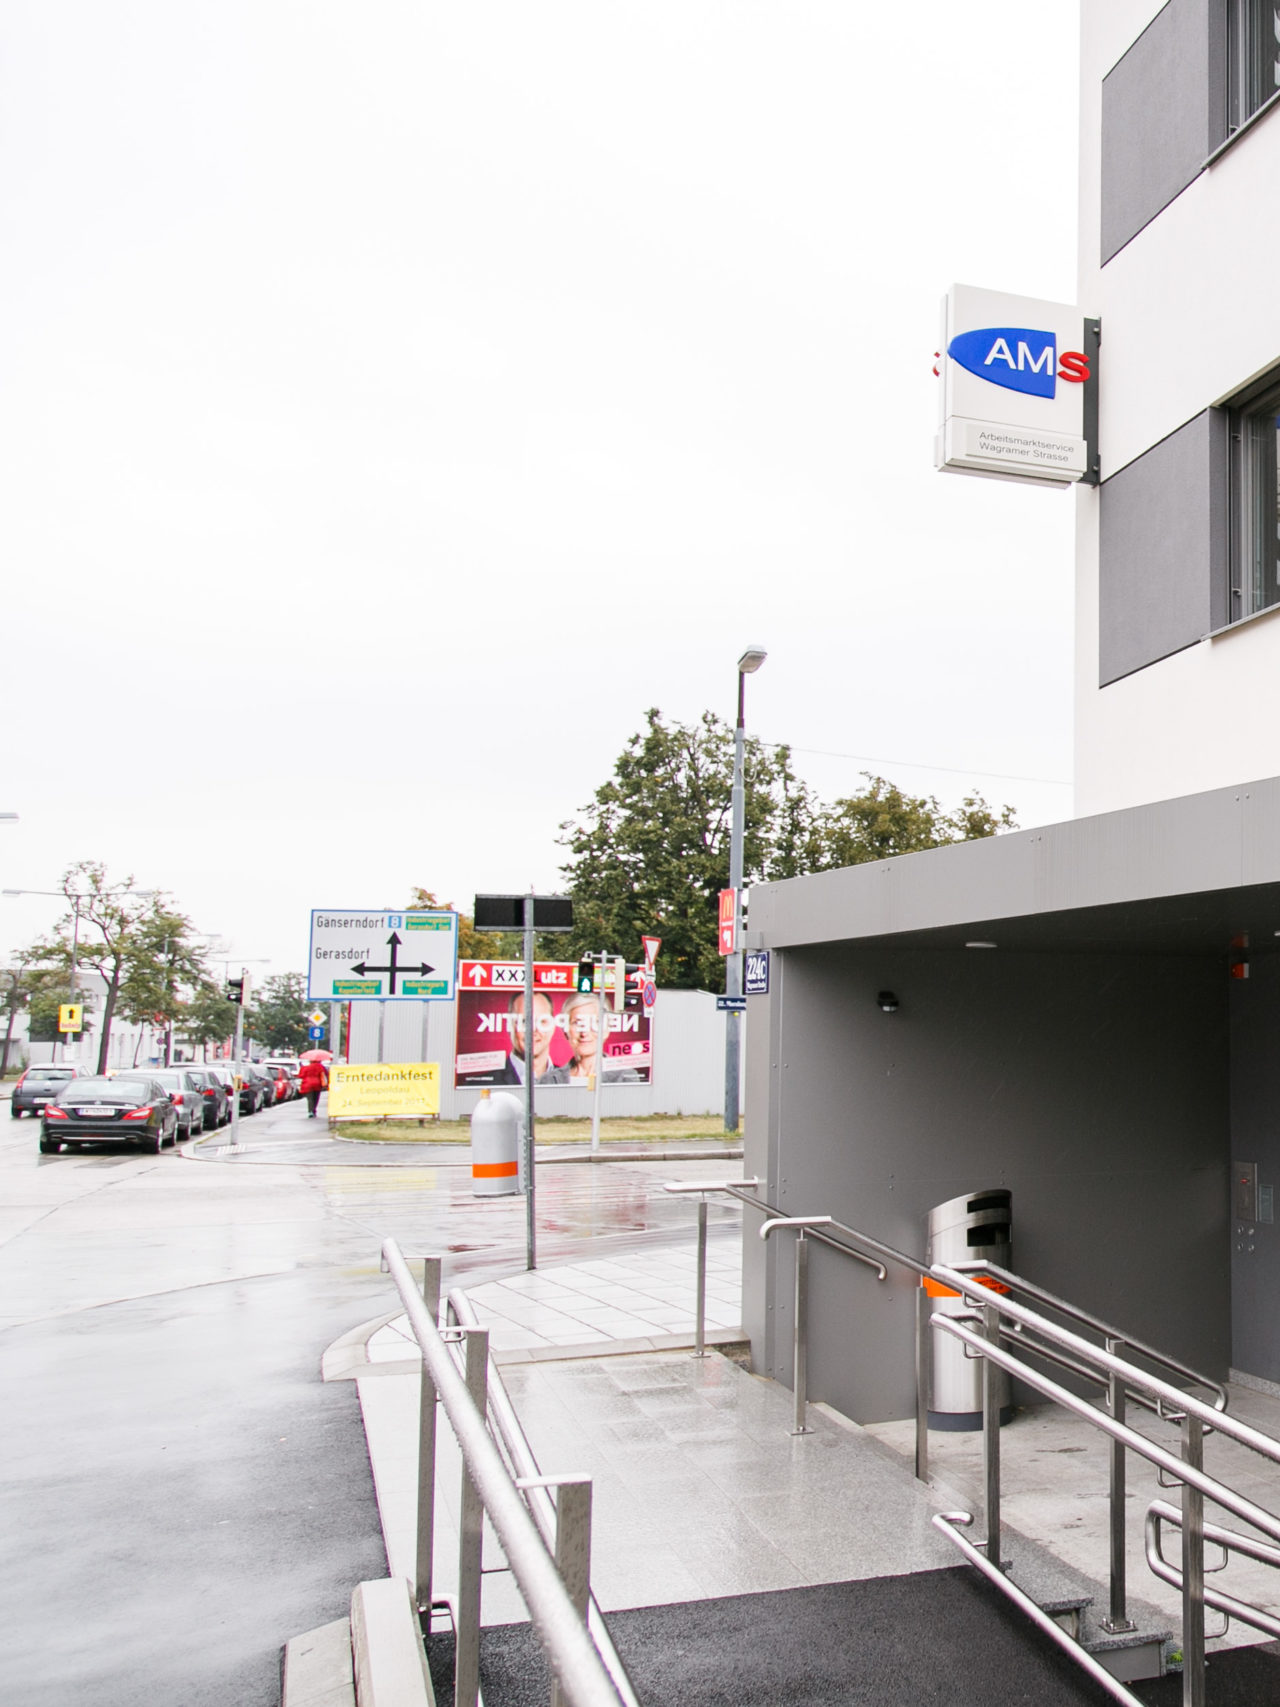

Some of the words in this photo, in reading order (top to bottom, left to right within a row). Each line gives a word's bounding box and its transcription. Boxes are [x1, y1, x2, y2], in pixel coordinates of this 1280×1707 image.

[984, 337, 1091, 383] AMS
[979, 431, 1074, 453] Arbeitsmarktservice
[979, 442, 1030, 457] Wagramer
[1033, 450, 1069, 462] Strasse
[317, 915, 385, 929] Gänserndorf
[315, 947, 370, 960] Gerasdorf
[313, 1028, 321, 1038] 8
[337, 1069, 433, 1083] Erntedankfest
[360, 1086, 410, 1095] Leopoldau
